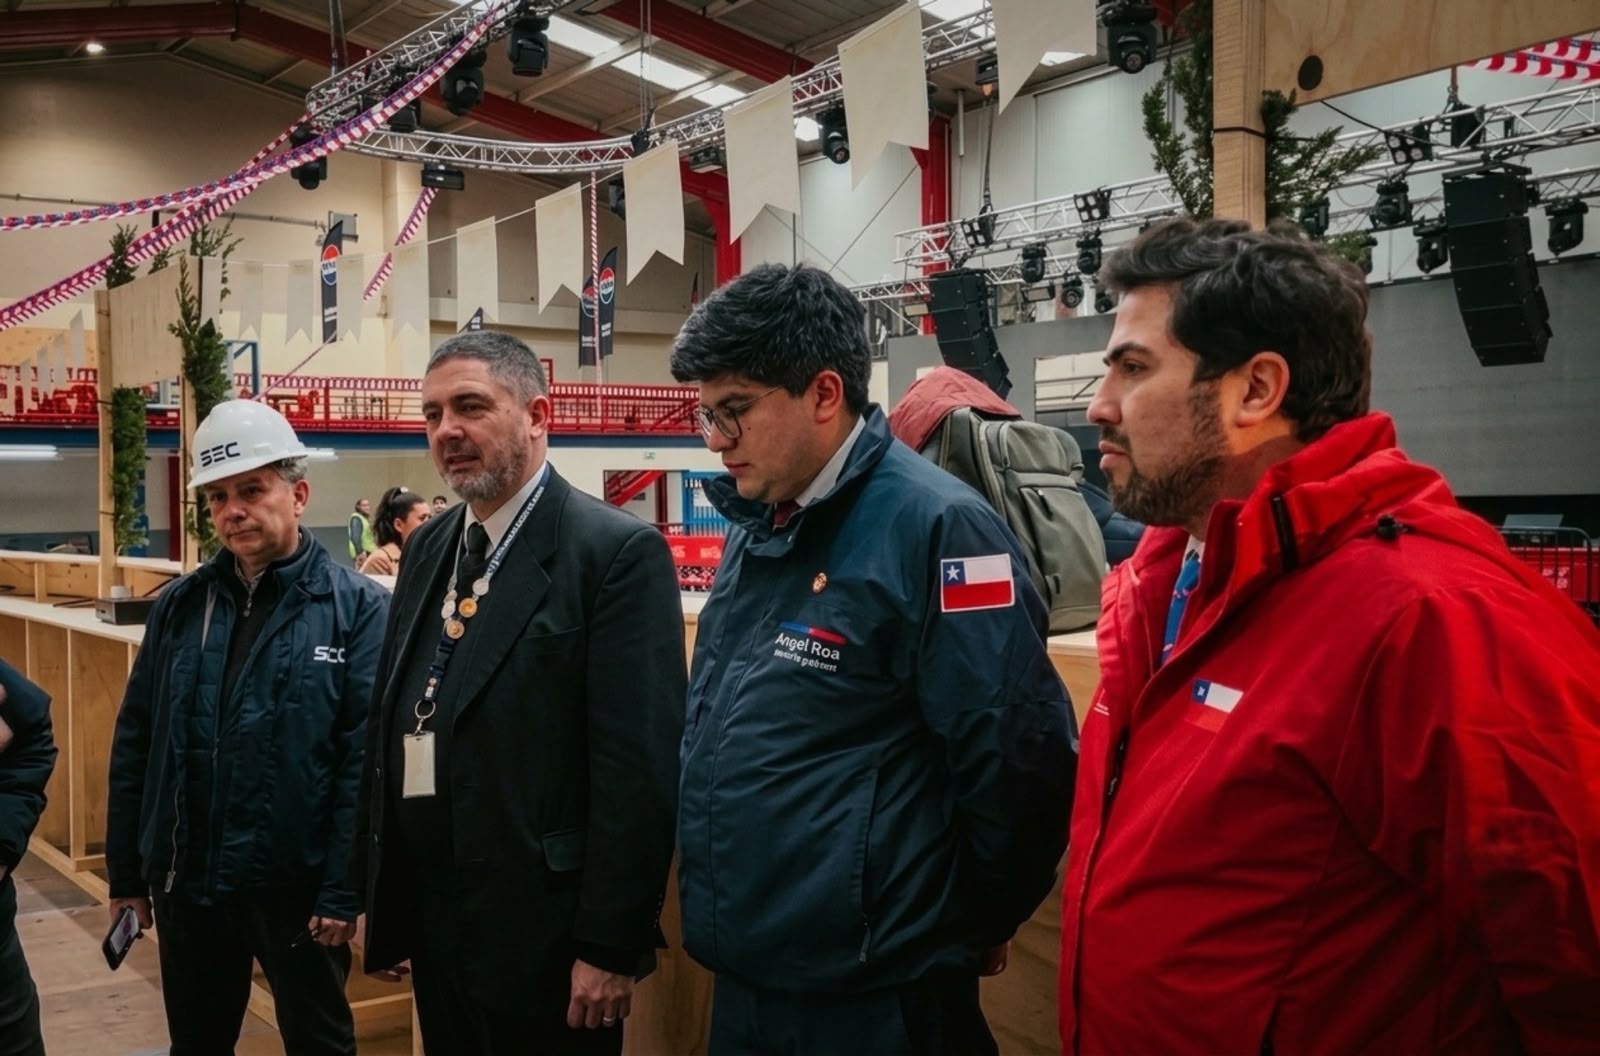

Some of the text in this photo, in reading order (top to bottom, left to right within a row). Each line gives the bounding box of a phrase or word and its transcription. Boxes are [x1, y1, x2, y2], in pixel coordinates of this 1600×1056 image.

[200, 441, 241, 468] SEC
[774, 632, 810, 652] Angel
[810, 641, 841, 661] Roa
